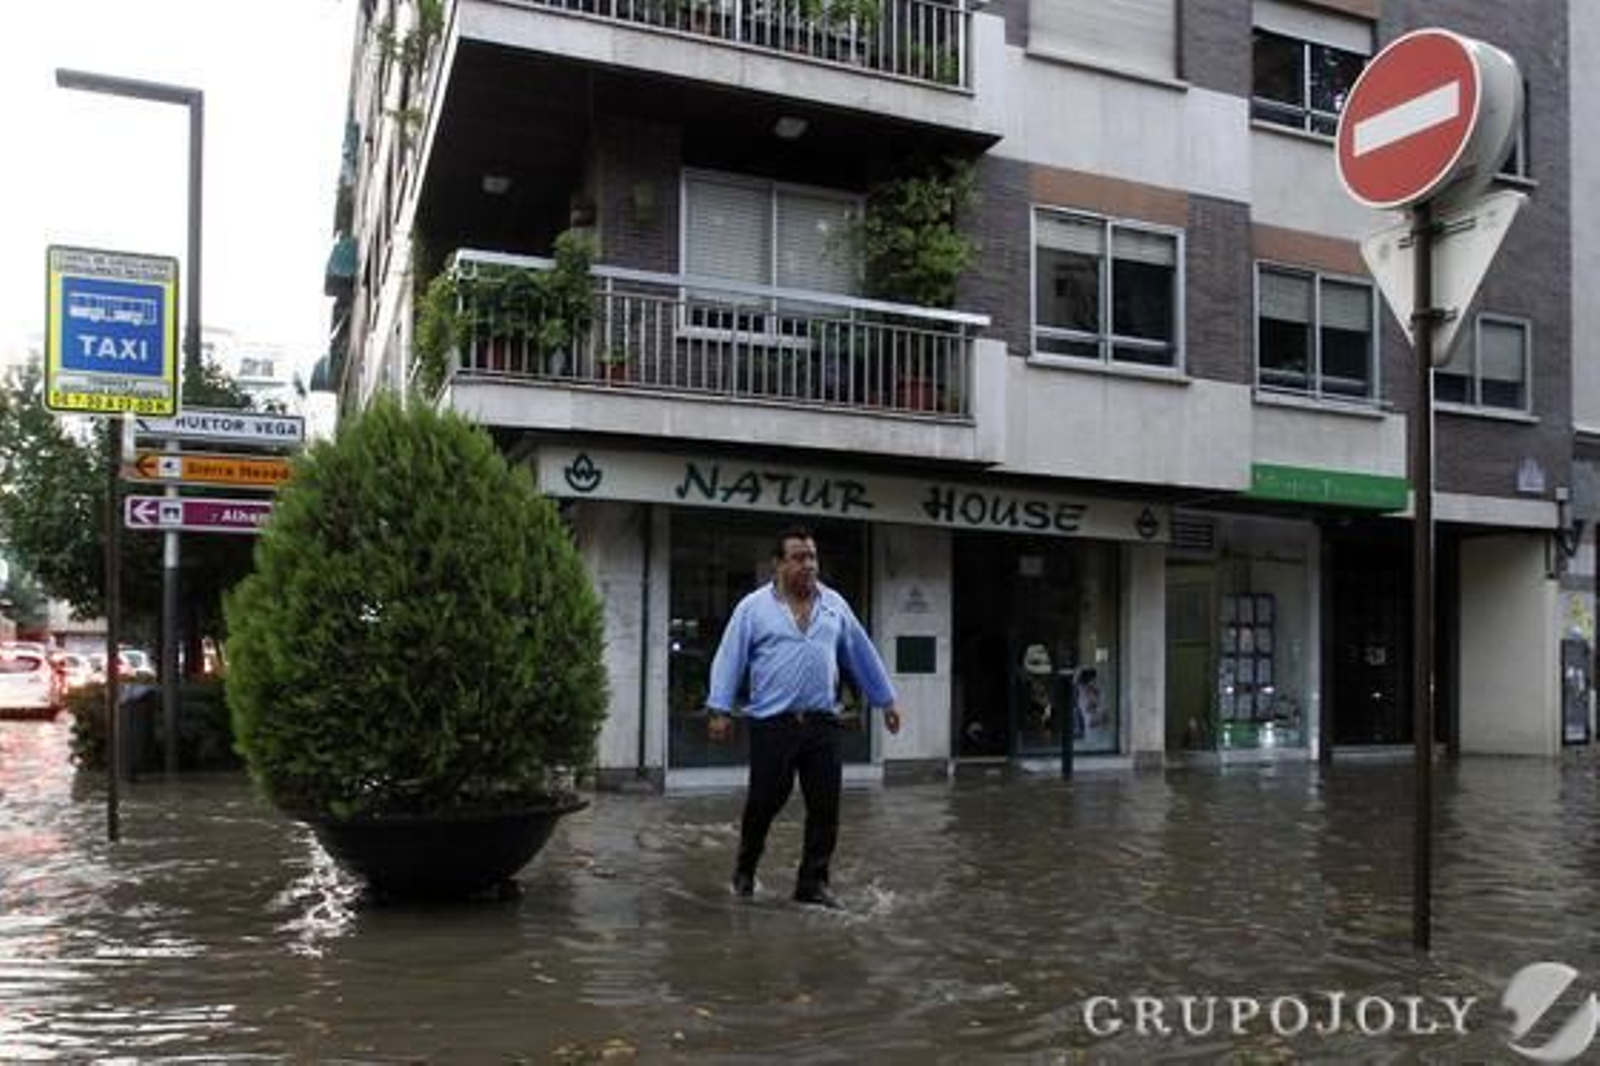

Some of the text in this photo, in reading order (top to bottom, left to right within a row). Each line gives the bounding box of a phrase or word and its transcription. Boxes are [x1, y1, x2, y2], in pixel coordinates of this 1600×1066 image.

[77, 334, 149, 362] TAXI
[175, 415, 298, 435] HUETOR VEGA
[187, 460, 289, 480] Sierra Nevad
[676, 462, 1090, 532] NATUR HOUSE
